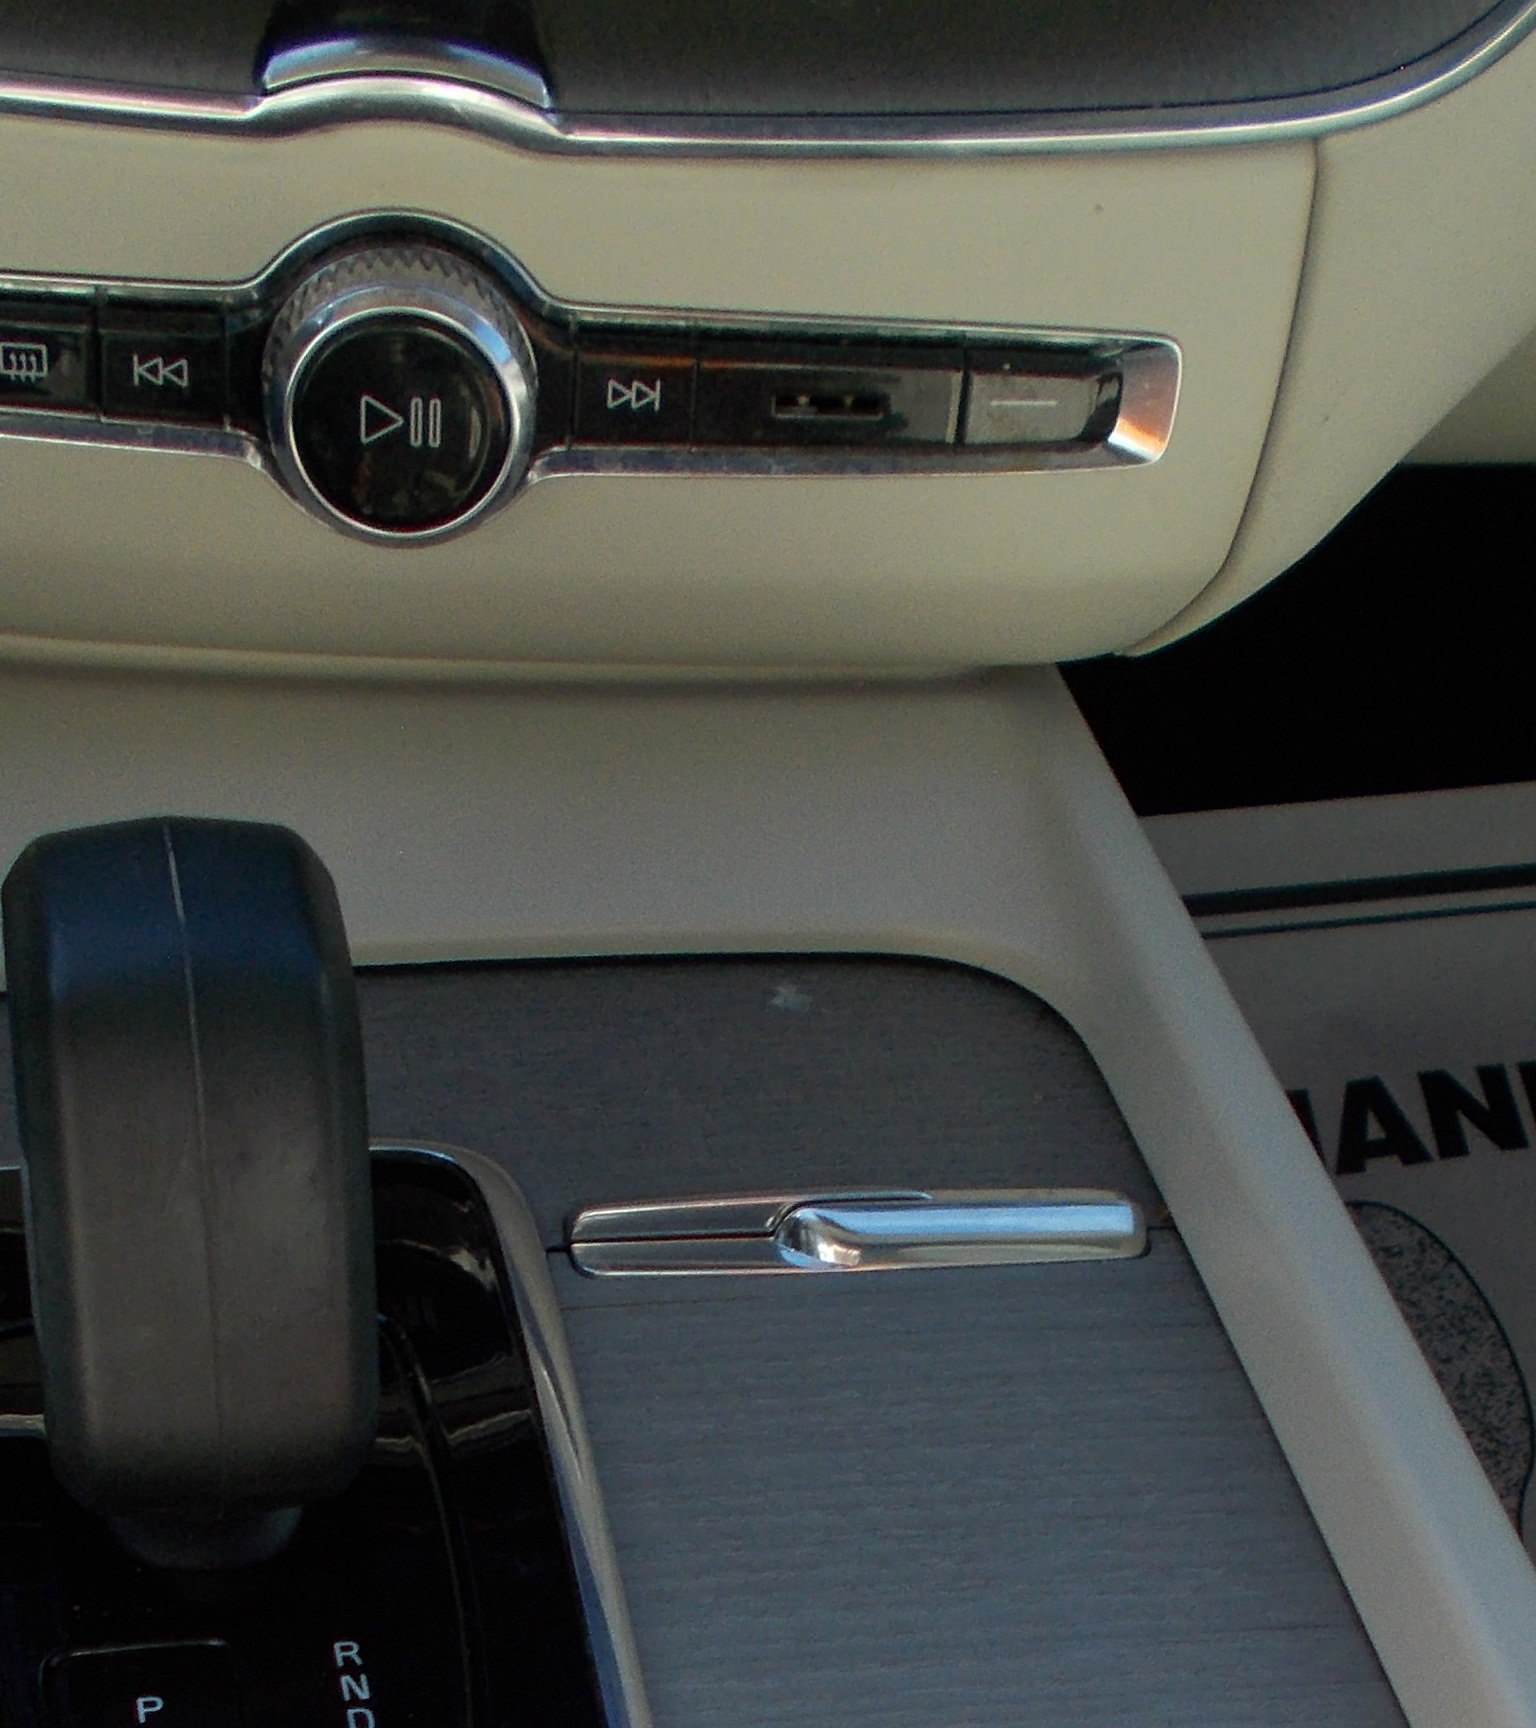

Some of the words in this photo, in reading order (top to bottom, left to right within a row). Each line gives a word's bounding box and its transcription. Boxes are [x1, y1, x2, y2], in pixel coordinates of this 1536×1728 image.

[331, 1640, 364, 1668] R
[339, 1672, 372, 1702] N
[135, 1694, 164, 1725] P
